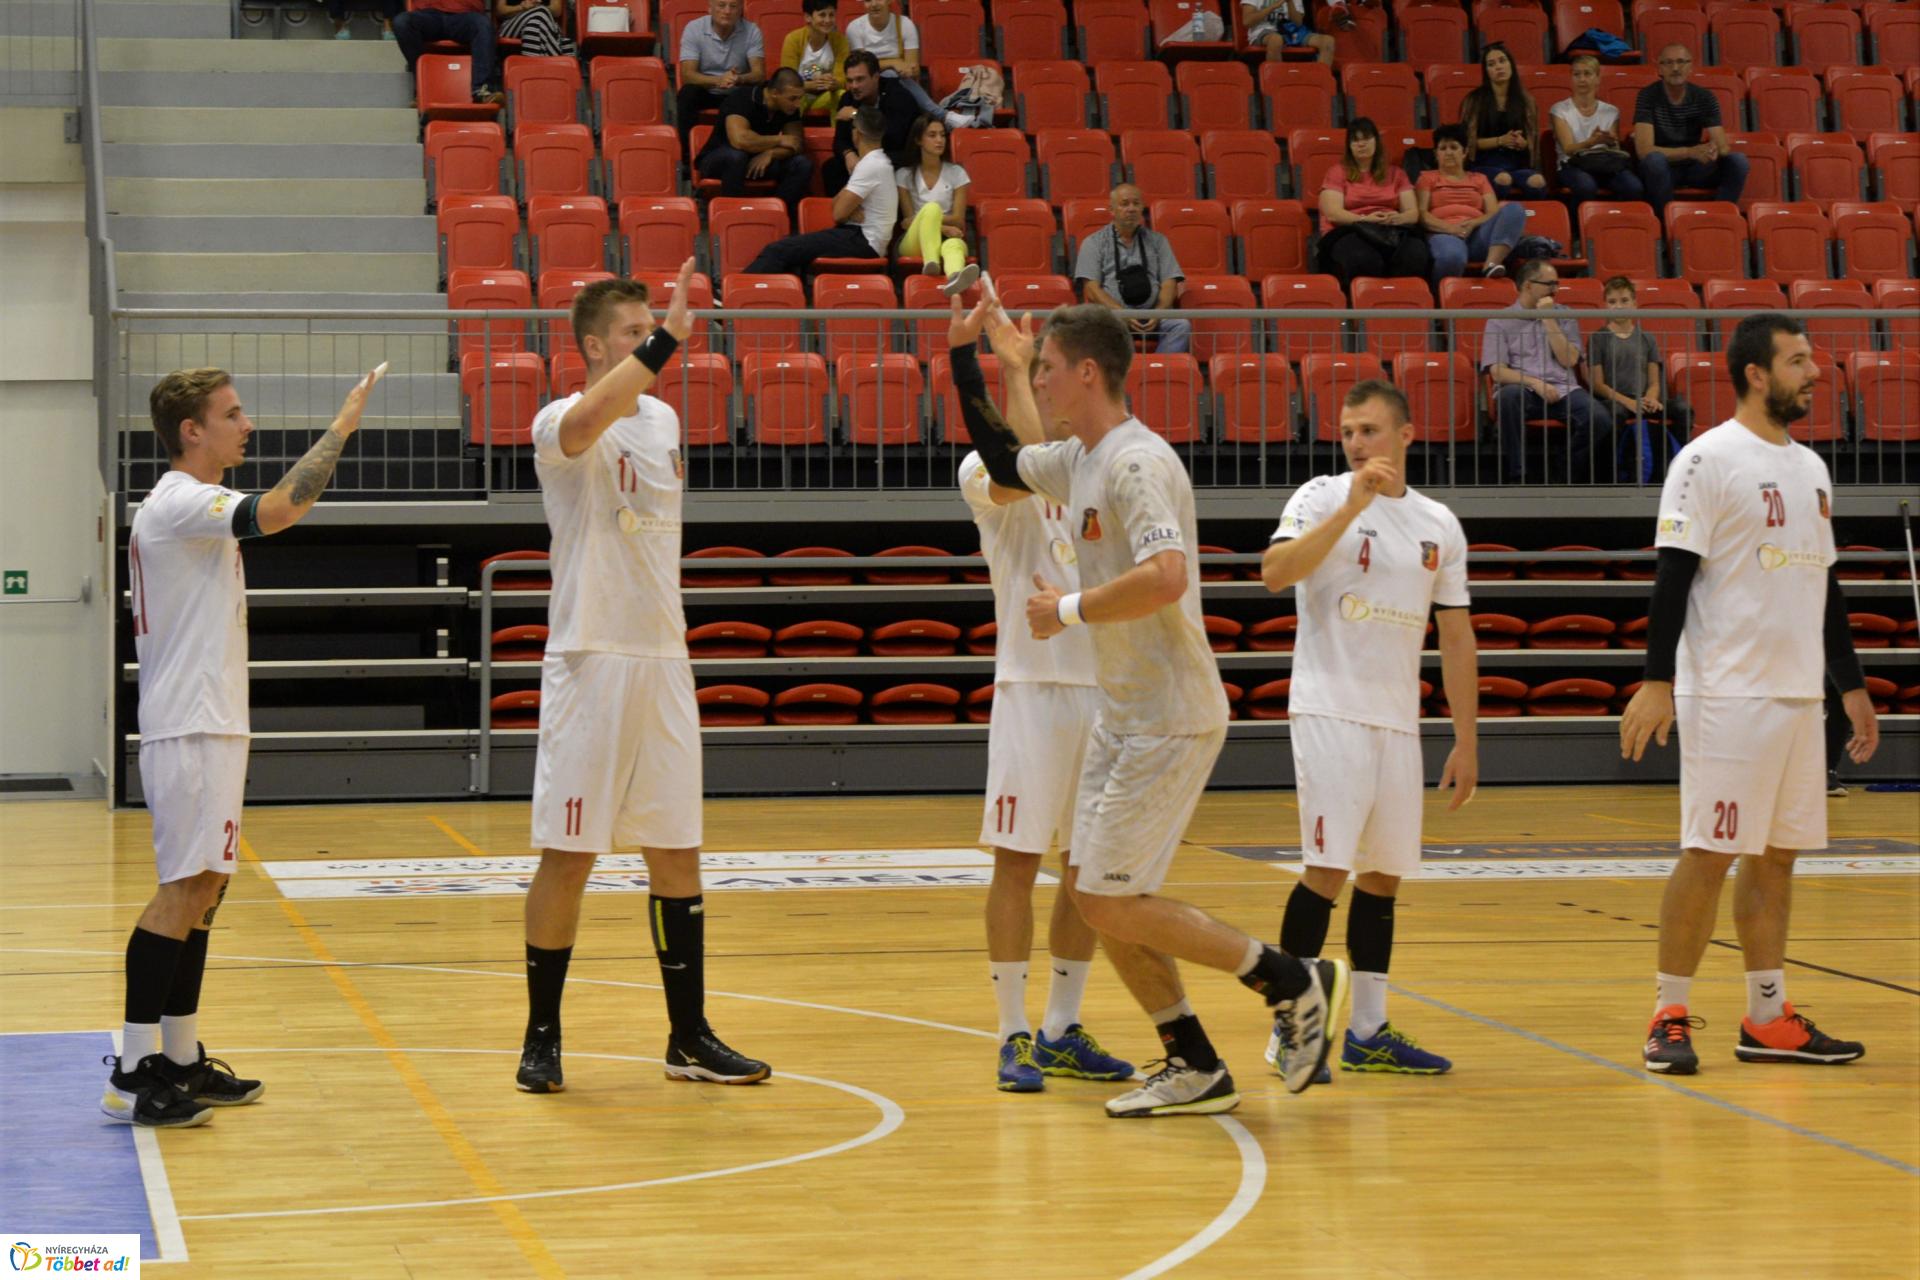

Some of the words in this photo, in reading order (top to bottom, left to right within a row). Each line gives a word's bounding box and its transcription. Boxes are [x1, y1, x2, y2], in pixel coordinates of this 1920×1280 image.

[619, 456, 637, 493] 11
[1763, 490, 1785, 527] 20
[1358, 537, 1370, 573] 4
[565, 797, 583, 836] 11
[996, 795, 1017, 834] 17
[1713, 800, 1738, 840] 20
[1314, 815, 1324, 854] 4
